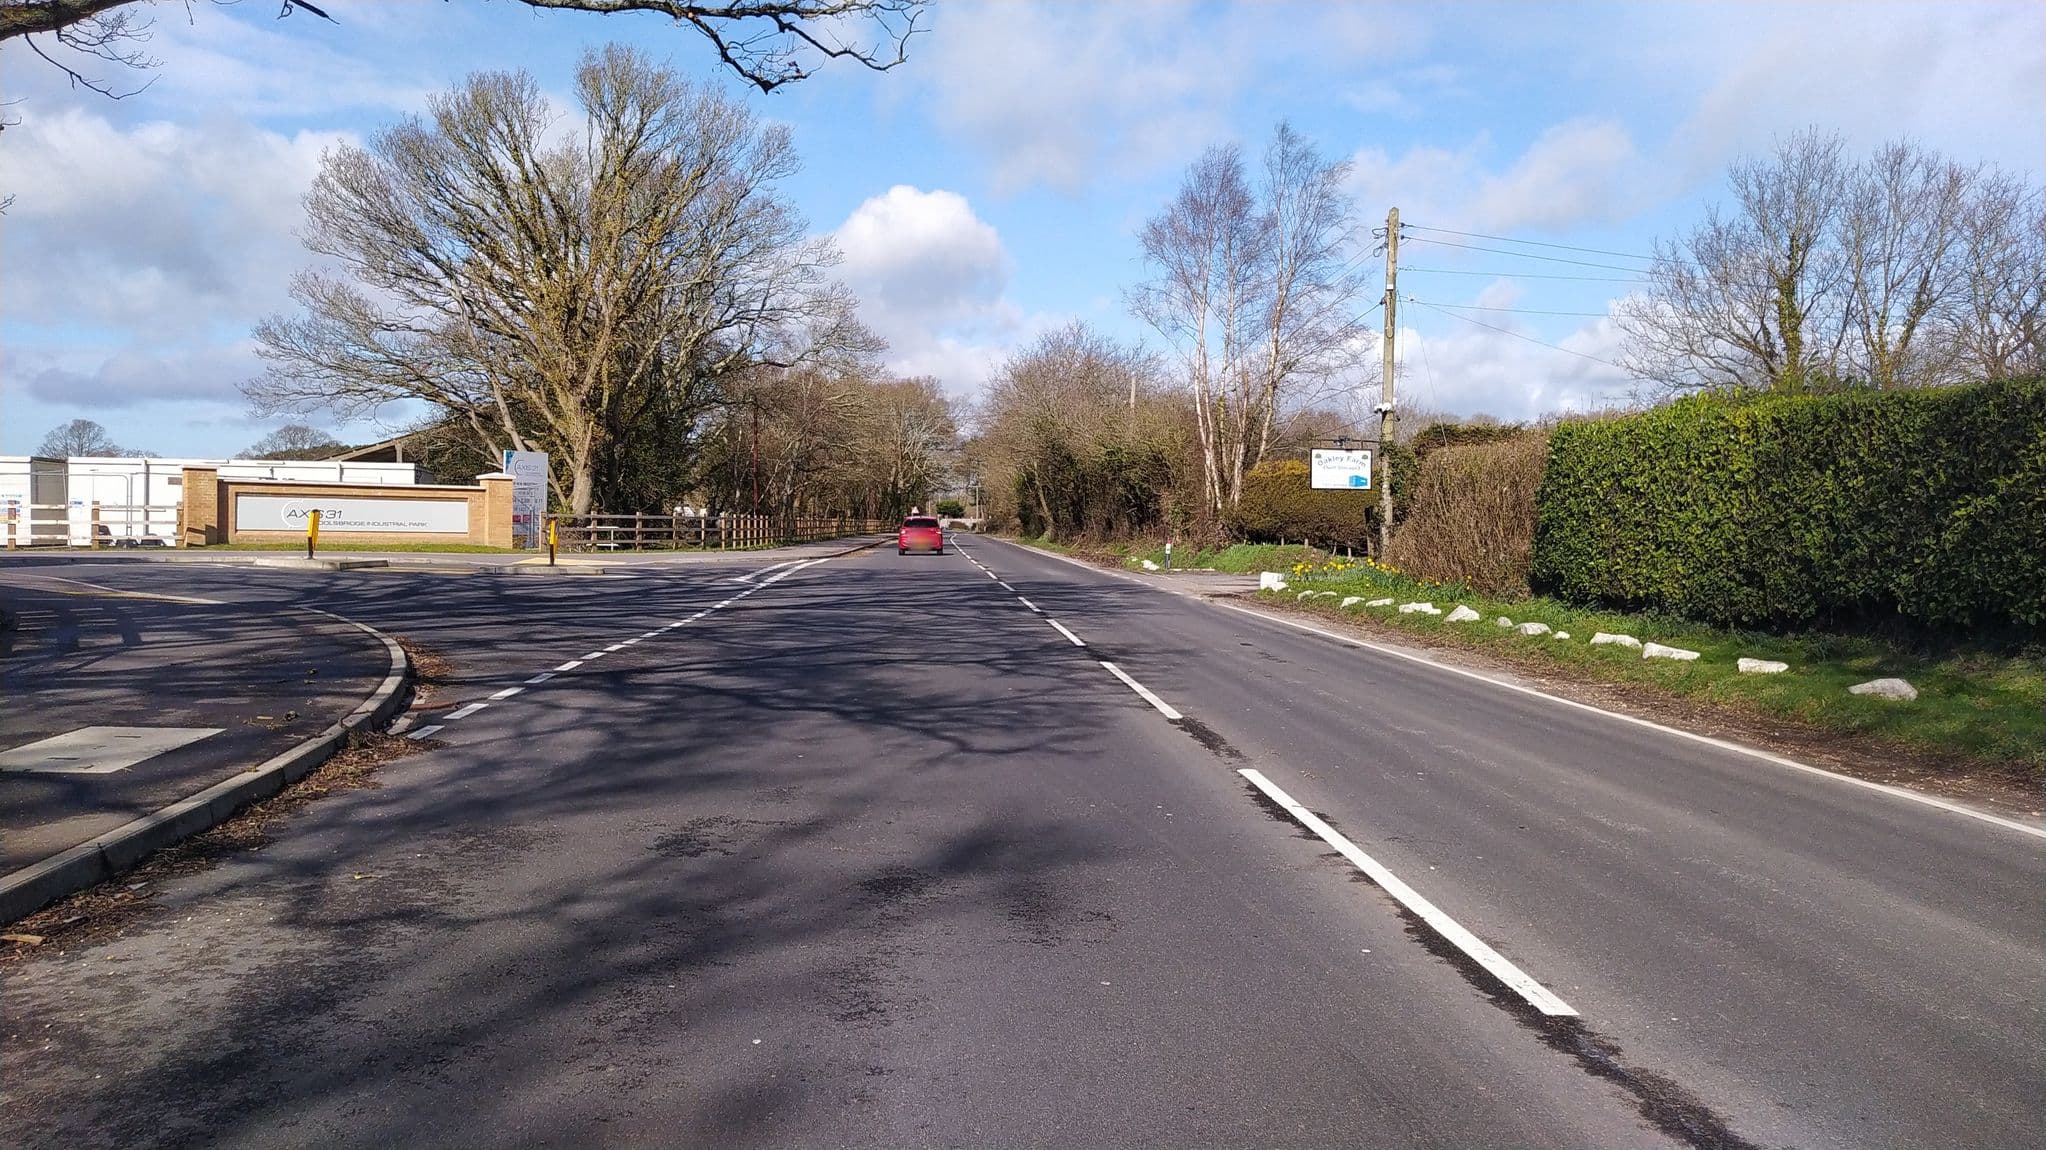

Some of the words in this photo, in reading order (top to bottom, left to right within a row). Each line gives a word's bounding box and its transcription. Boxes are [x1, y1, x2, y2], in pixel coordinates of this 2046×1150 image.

[1318, 456, 1344, 466] Oakley
[1346, 456, 1366, 467] Farm
[287, 509, 342, 519] AXS31
